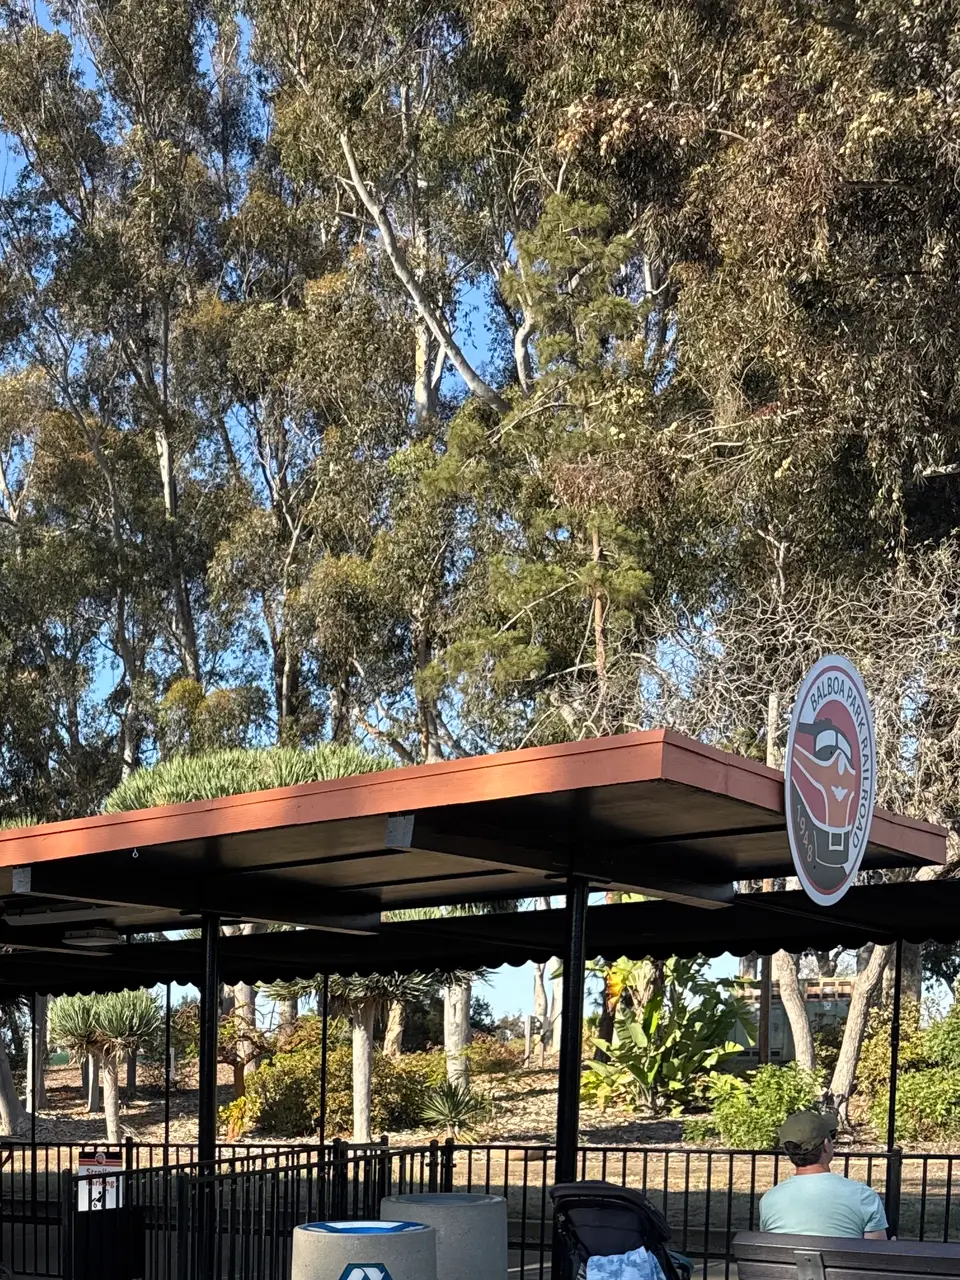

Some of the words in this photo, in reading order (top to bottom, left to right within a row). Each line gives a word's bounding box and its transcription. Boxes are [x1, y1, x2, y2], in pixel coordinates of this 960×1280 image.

[810, 676, 845, 713] BALBOA
[846, 688, 866, 732] PARK
[852, 737, 872, 849] RAILROAD
[796, 804, 813, 863] 1948
[86, 1179, 115, 1189] Parkng
